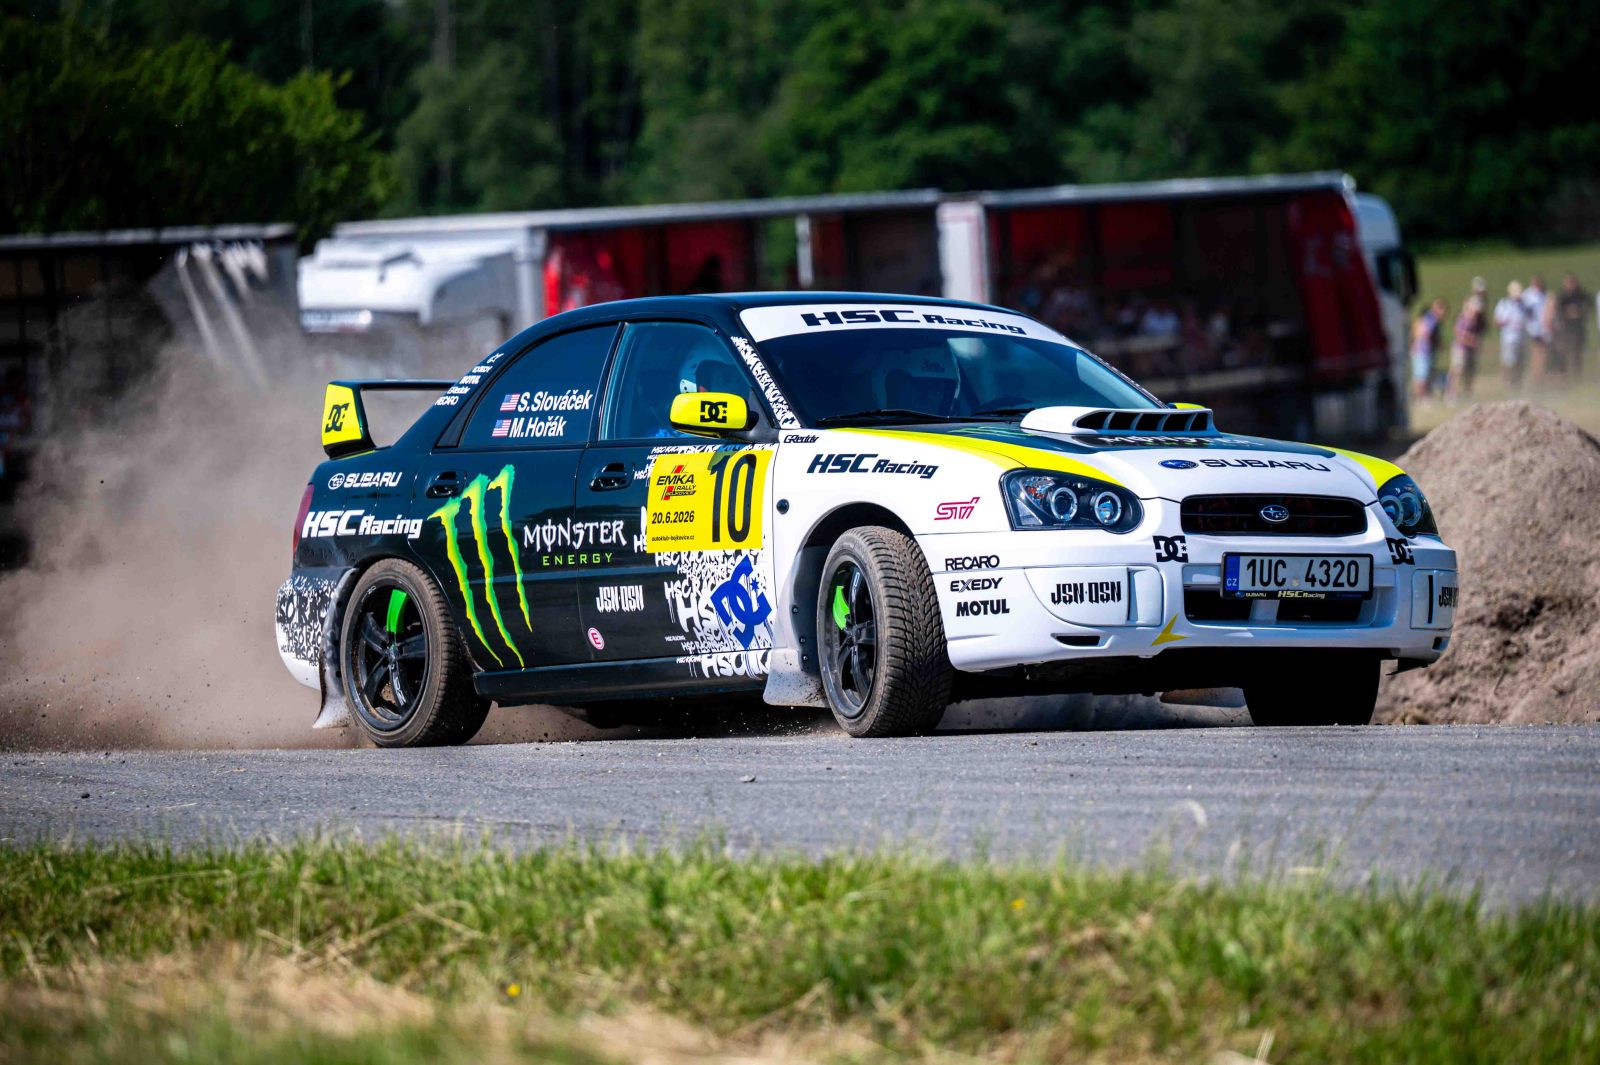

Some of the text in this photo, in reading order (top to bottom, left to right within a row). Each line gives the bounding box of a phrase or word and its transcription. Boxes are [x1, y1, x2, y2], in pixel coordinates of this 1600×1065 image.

[801, 310, 1027, 336] HSC Racing
[517, 389, 593, 412] S.Slováček
[508, 416, 567, 438] M.Hořák
[806, 453, 939, 479] HSC Racing
[1199, 458, 1332, 473] SUBARU
[343, 472, 403, 488] SUBARU
[656, 474, 695, 486] EMKA
[709, 453, 757, 543] 10
[301, 509, 423, 539] HSC Racing
[651, 511, 695, 525] 20.6.2026
[523, 517, 628, 552] MONSTER
[651, 534, 695, 543] autoklub-bojkovice.cz
[542, 552, 613, 566] ENERGY
[944, 554, 1000, 571] RECARO
[1246, 558, 1360, 588] 1UC 4320
[950, 577, 1003, 592] EXEDY
[1226, 577, 1238, 587] CZ
[1277, 590, 1304, 598] HSC
[956, 599, 1010, 617] MOTUL
[591, 632, 602, 645] E
